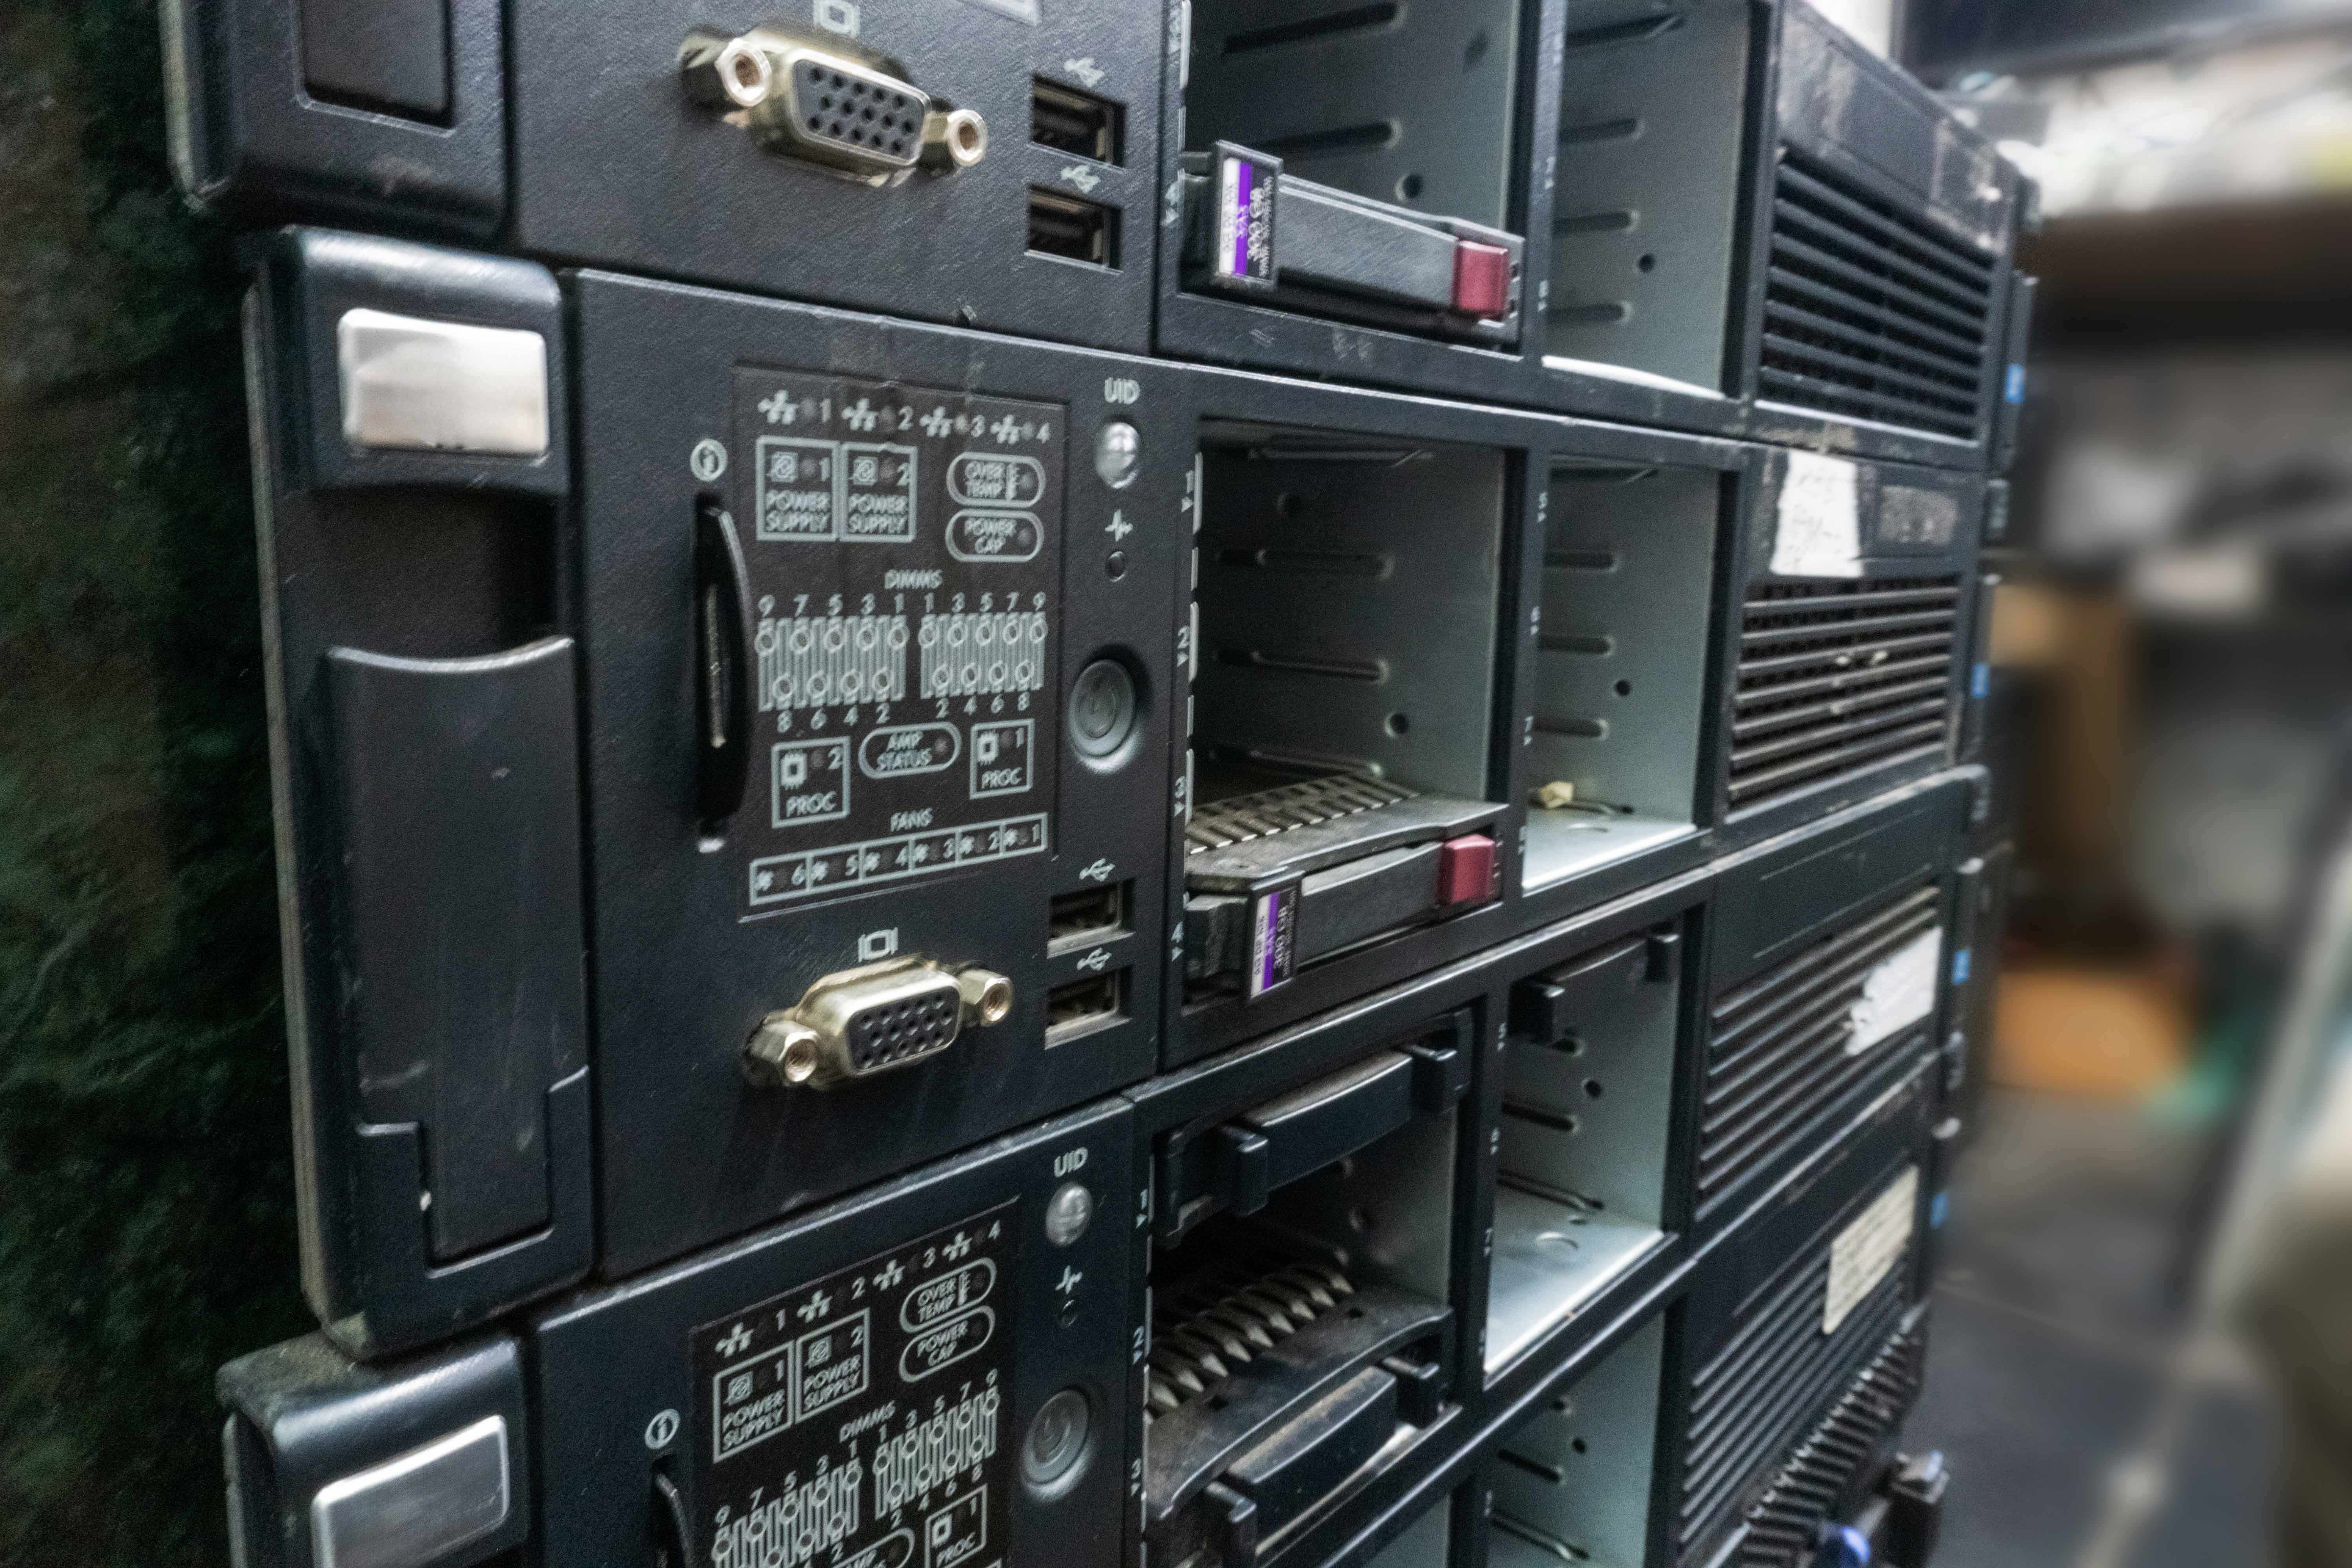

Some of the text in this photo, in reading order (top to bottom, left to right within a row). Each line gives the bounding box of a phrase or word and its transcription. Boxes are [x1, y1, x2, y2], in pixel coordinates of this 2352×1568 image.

[1104, 377, 1140, 404] UID
[820, 398, 831, 422] 1
[898, 406, 914, 430] 2
[970, 414, 986, 437] 3
[1036, 422, 1051, 443] 4
[818, 457, 831, 481] 1
[897, 462, 909, 486] 2
[964, 461, 1005, 479] OVER
[965, 478, 1004, 499] TEMP
[765, 491, 830, 513] POWER
[849, 494, 909, 514] POWER
[765, 512, 831, 534] SUPPLY
[849, 513, 907, 534] SUPPLY
[964, 517, 1017, 537] POWER
[975, 535, 1007, 554] CAP
[884, 569, 942, 590] DIMMS
[758, 593, 905, 617] 9 7 5 3 1
[925, 591, 1046, 612] 1 3 5 7 9
[1177, 626, 1190, 650] 2
[936, 692, 1030, 719] 2 4 6 8
[777, 703, 891, 733] 8 6 4 2
[887, 731, 924, 751] AMP
[1016, 728, 1024, 748] 1
[828, 747, 843, 771] 2
[877, 749, 932, 771] STATUS
[982, 768, 1023, 789] PROC
[786, 791, 837, 818] PROC
[890, 808, 933, 831] FANS
[792, 824, 1040, 885] 6 5 4 3 2 1
[1265, 926, 1276, 956] SAS
[1273, 905, 1289, 969] 300 GB
[1054, 1147, 1088, 1177] UID
[1140, 1189, 1147, 1210] 1
[988, 1220, 1001, 1240] 4
[923, 1247, 936, 1269] 3
[851, 1276, 866, 1300] 2
[917, 1275, 957, 1305] OVER
[775, 1308, 786, 1331] 1
[918, 1294, 955, 1323] TEMP
[850, 1326, 863, 1348] 2
[917, 1319, 969, 1357] POWER
[1133, 1326, 1144, 1349] 2
[927, 1341, 958, 1368] CAP
[775, 1359, 784, 1382] 1
[803, 1355, 861, 1392] POWER
[803, 1374, 860, 1411] SUPPLY
[723, 1390, 785, 1434] POWER
[879, 1370, 998, 1442] 1 3 5 7 9
[723, 1407, 784, 1450] SUPPLY
[839, 1400, 896, 1443] DIMMS
[1131, 1458, 1142, 1479] 3
[715, 1439, 858, 1527] 9 7 5 3 1
[891, 1463, 983, 1528] 2 4 6 8
[970, 1497, 977, 1516] 1
[831, 1542, 845, 1561] 2
[936, 1532, 975, 1567] PROC
